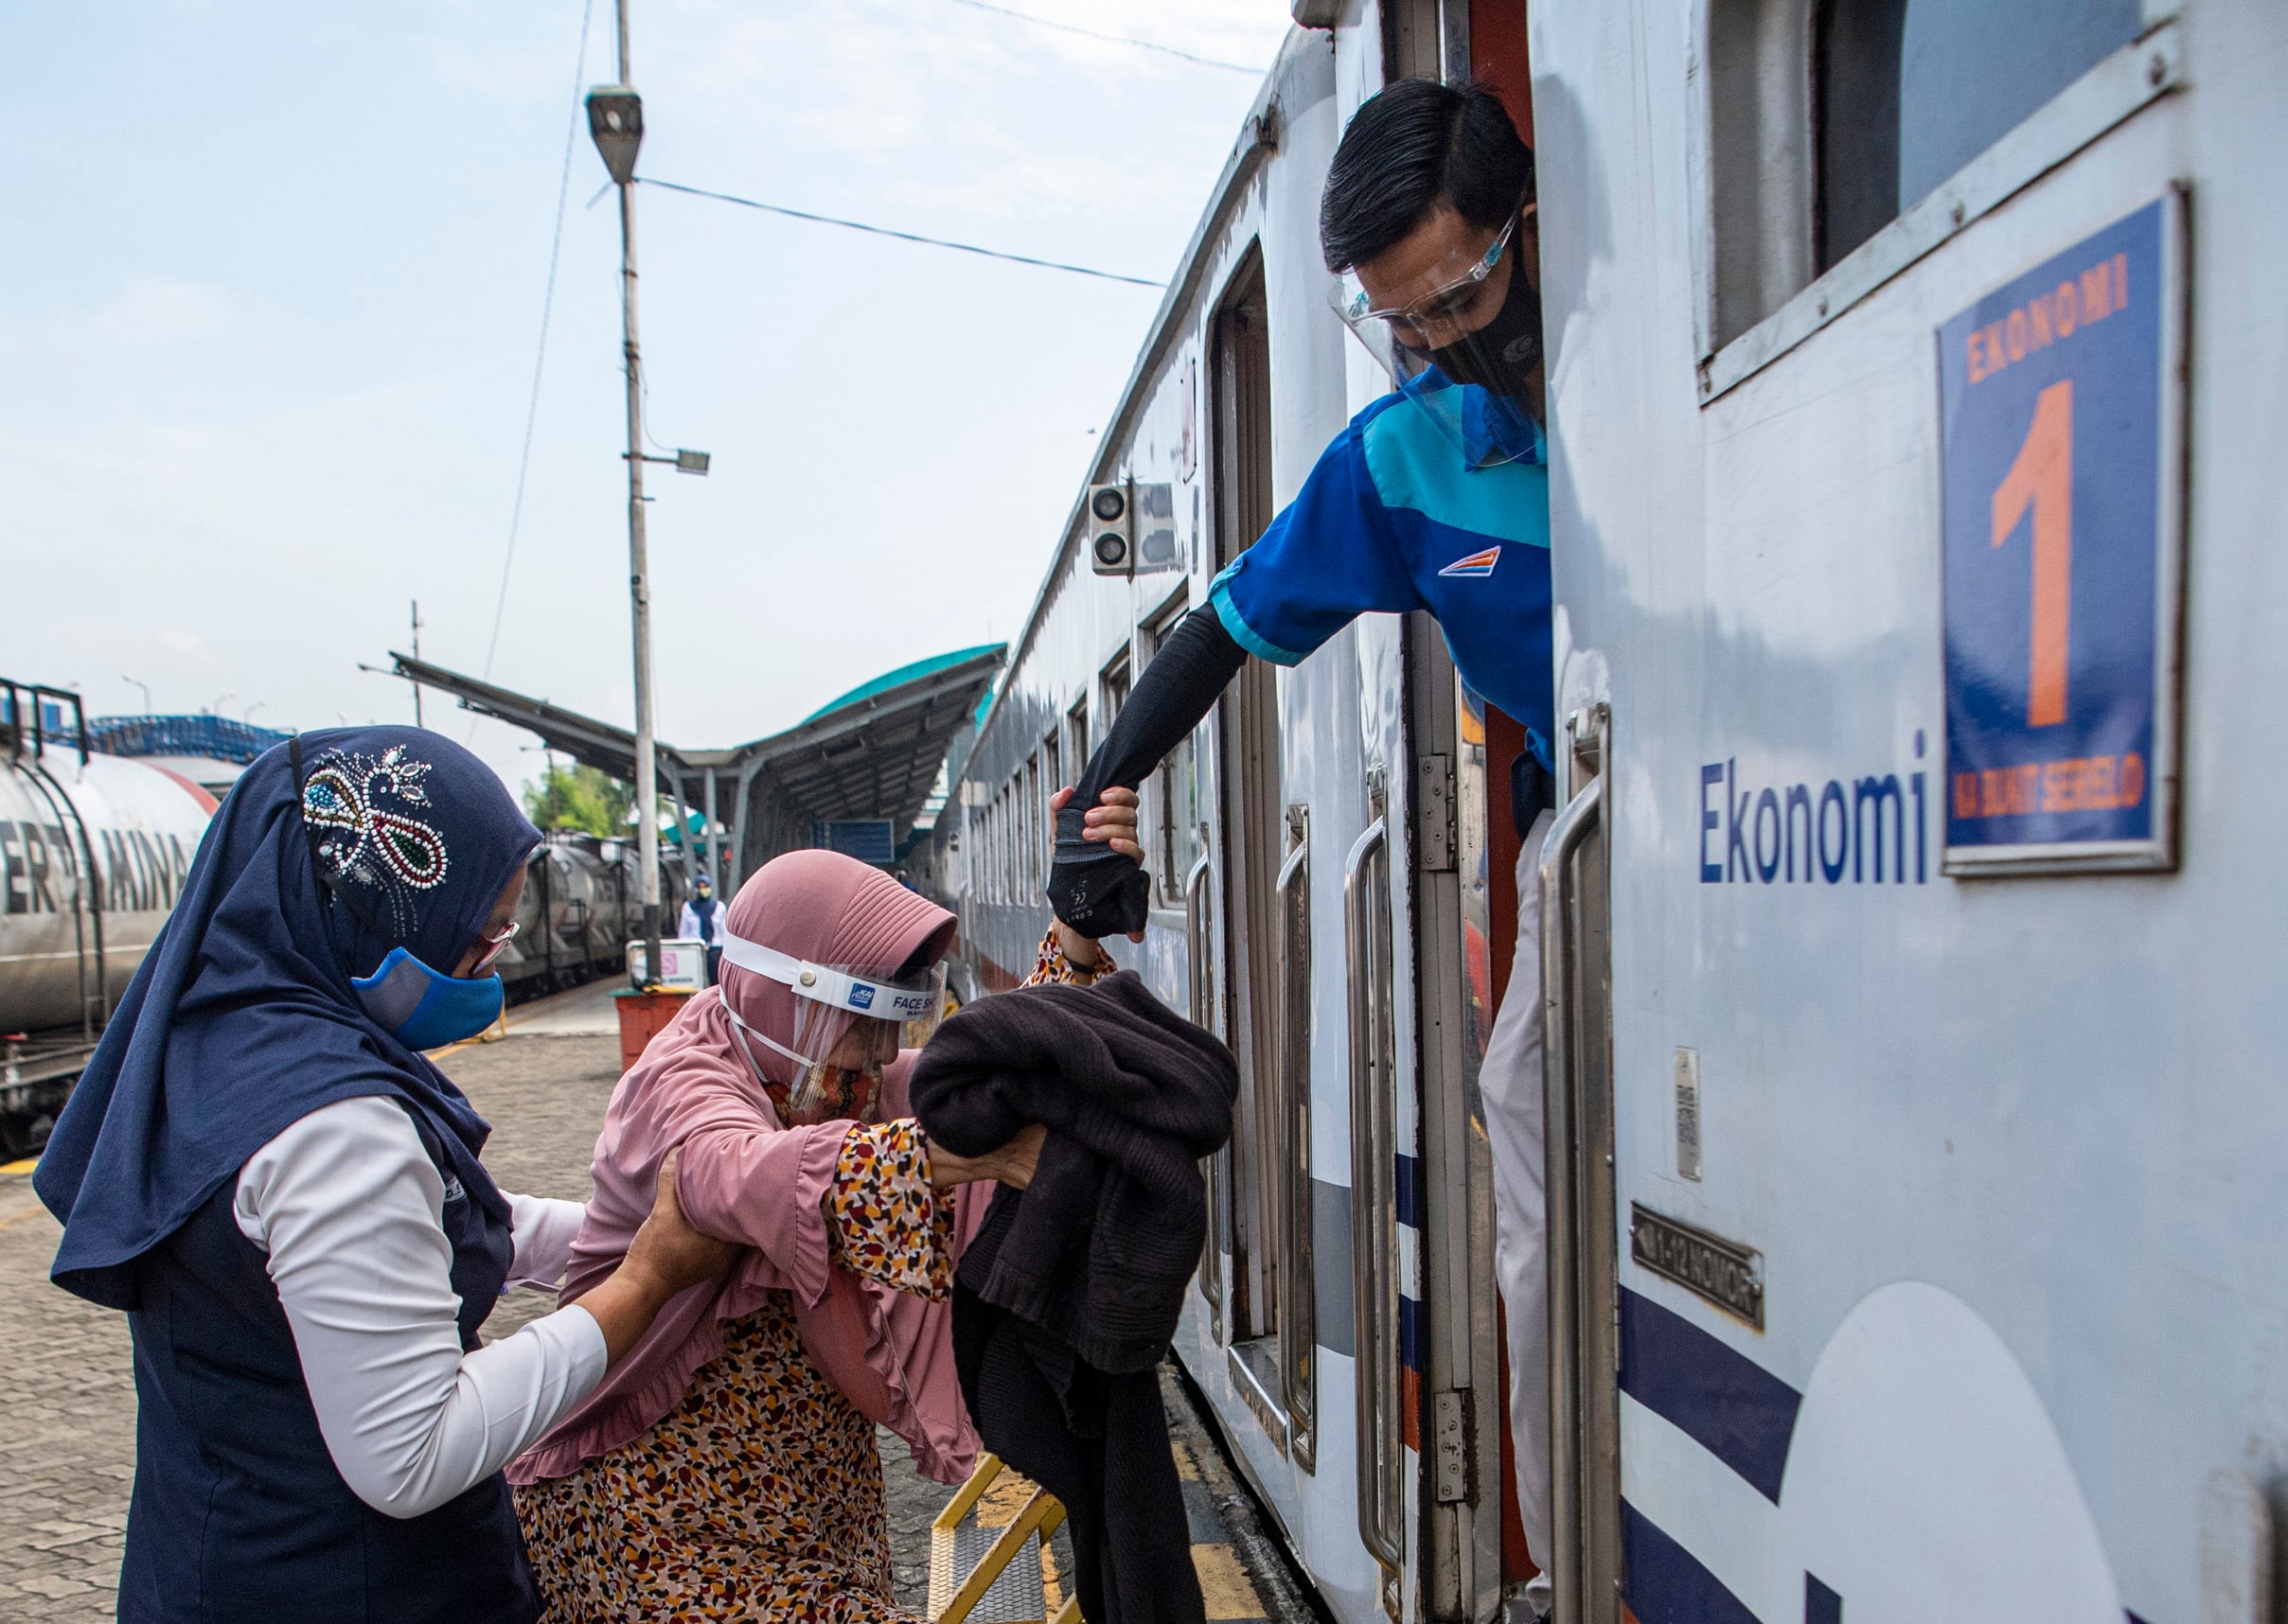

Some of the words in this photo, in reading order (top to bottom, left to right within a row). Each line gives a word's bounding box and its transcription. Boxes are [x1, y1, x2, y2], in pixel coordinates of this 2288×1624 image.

[1967, 253, 2129, 384] EKONOMI
[1992, 379, 2073, 728] 1
[1700, 728, 1926, 885] Ekonomi
[893, 996, 922, 1010] FACE
